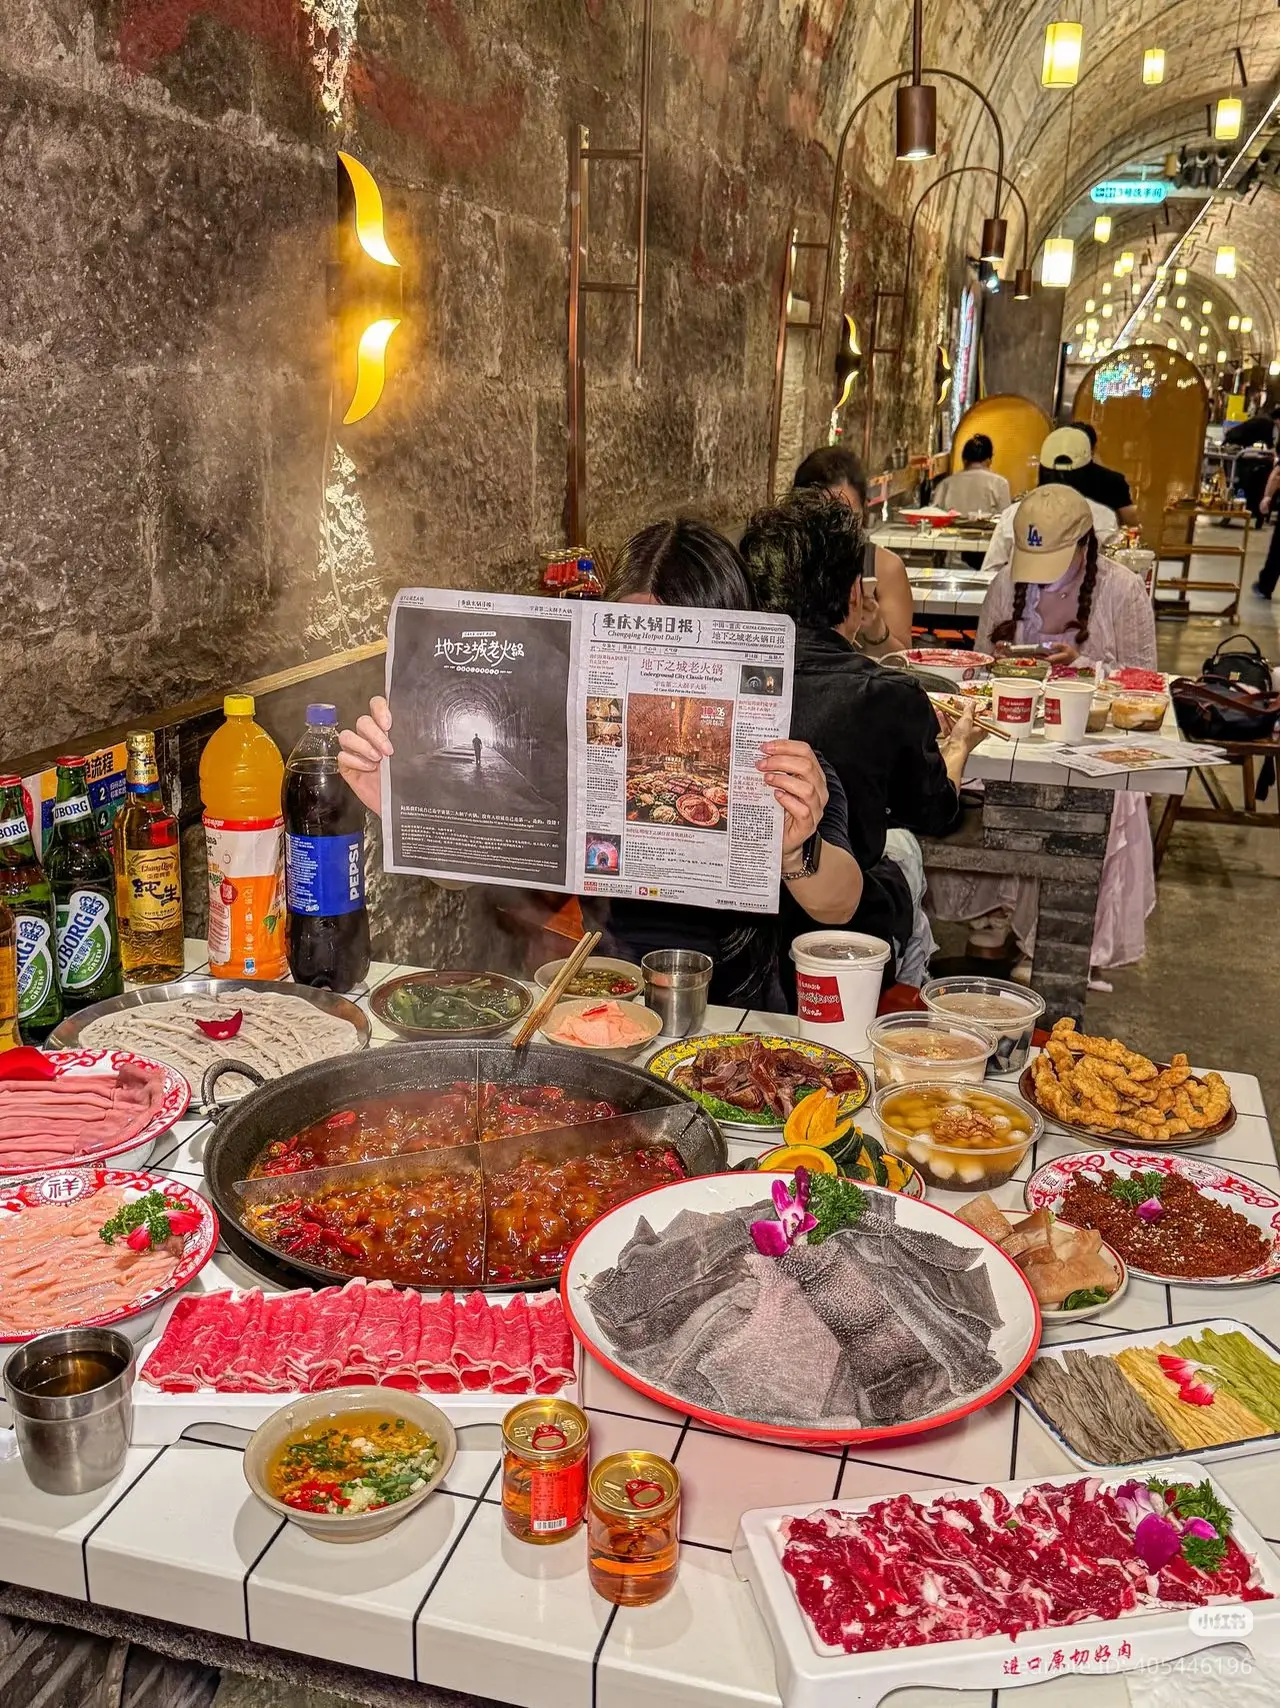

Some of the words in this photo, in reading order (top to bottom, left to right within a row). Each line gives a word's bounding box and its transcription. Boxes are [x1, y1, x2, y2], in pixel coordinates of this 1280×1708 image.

[1027, 524, 1043, 546] LA
[602, 613, 693, 634] 重庆火锅日报
[607, 630, 641, 640] Chongqing
[642, 633, 664, 641] Hotpot
[665, 634, 683, 642] Daily
[711, 630, 785, 645] 地下之城老火锅日报
[434, 637, 525, 667] 地下之城老火锅
[640, 671, 674, 679] Underground
[704, 675, 723, 683] Hotpot
[641, 658, 724, 676] 地下之城老火锅
[99, 787, 106, 801] 2
[54, 800, 88, 819] UBORG
[100, 812, 106, 825] 4
[348, 843, 360, 901] PEPSI
[58, 912, 95, 970] UBORG
[87, 947, 103, 972] GREEN
[30, 975, 45, 1000] GREEN
[48, 1178, 80, 1198] 祥
[1002, 1640, 1133, 1676] 进口原切好肉
